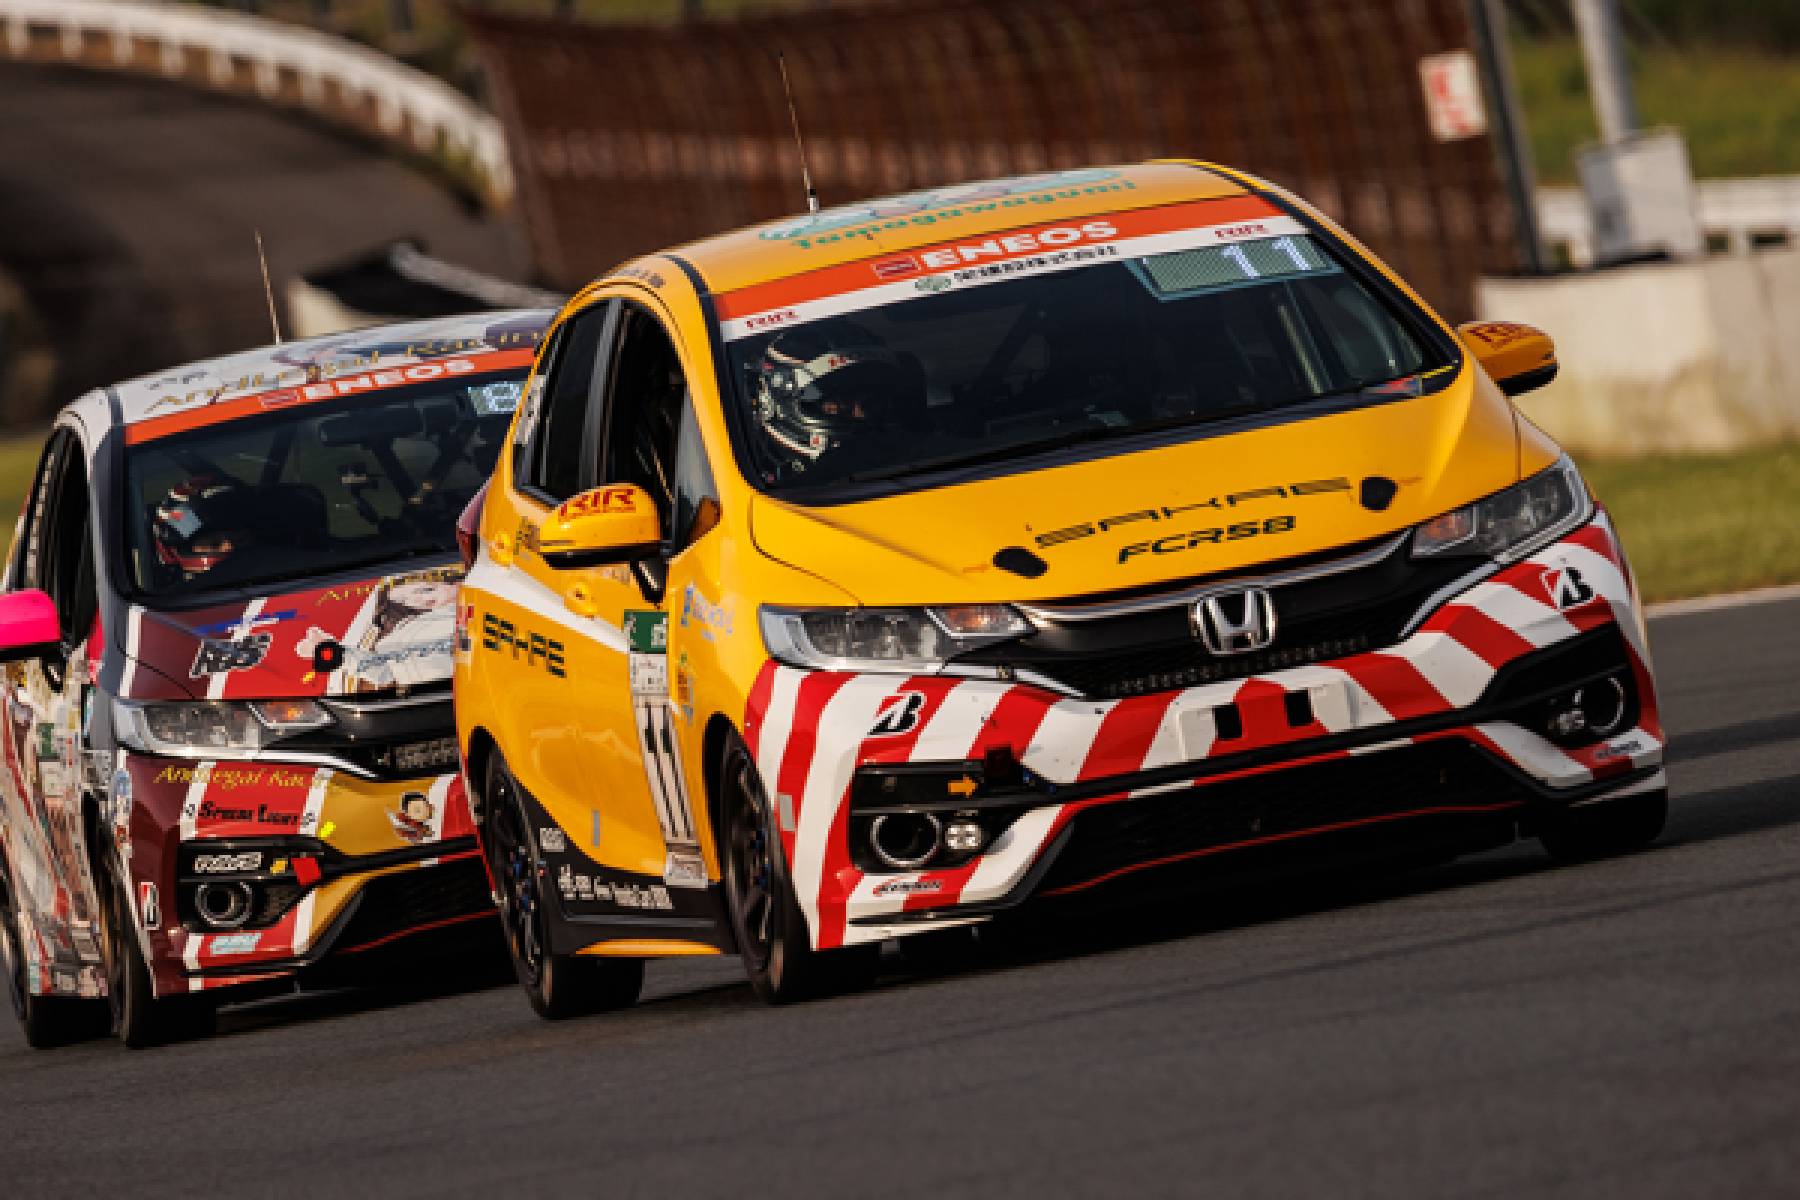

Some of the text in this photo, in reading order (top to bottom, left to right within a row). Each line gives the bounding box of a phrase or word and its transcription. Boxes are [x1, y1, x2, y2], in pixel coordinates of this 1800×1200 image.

[919, 222, 1118, 269] ENEOS
[1223, 235, 1312, 280] 11
[303, 359, 476, 400] ENEOS
[559, 484, 634, 518] RIR
[1117, 515, 1297, 564] FCR58
